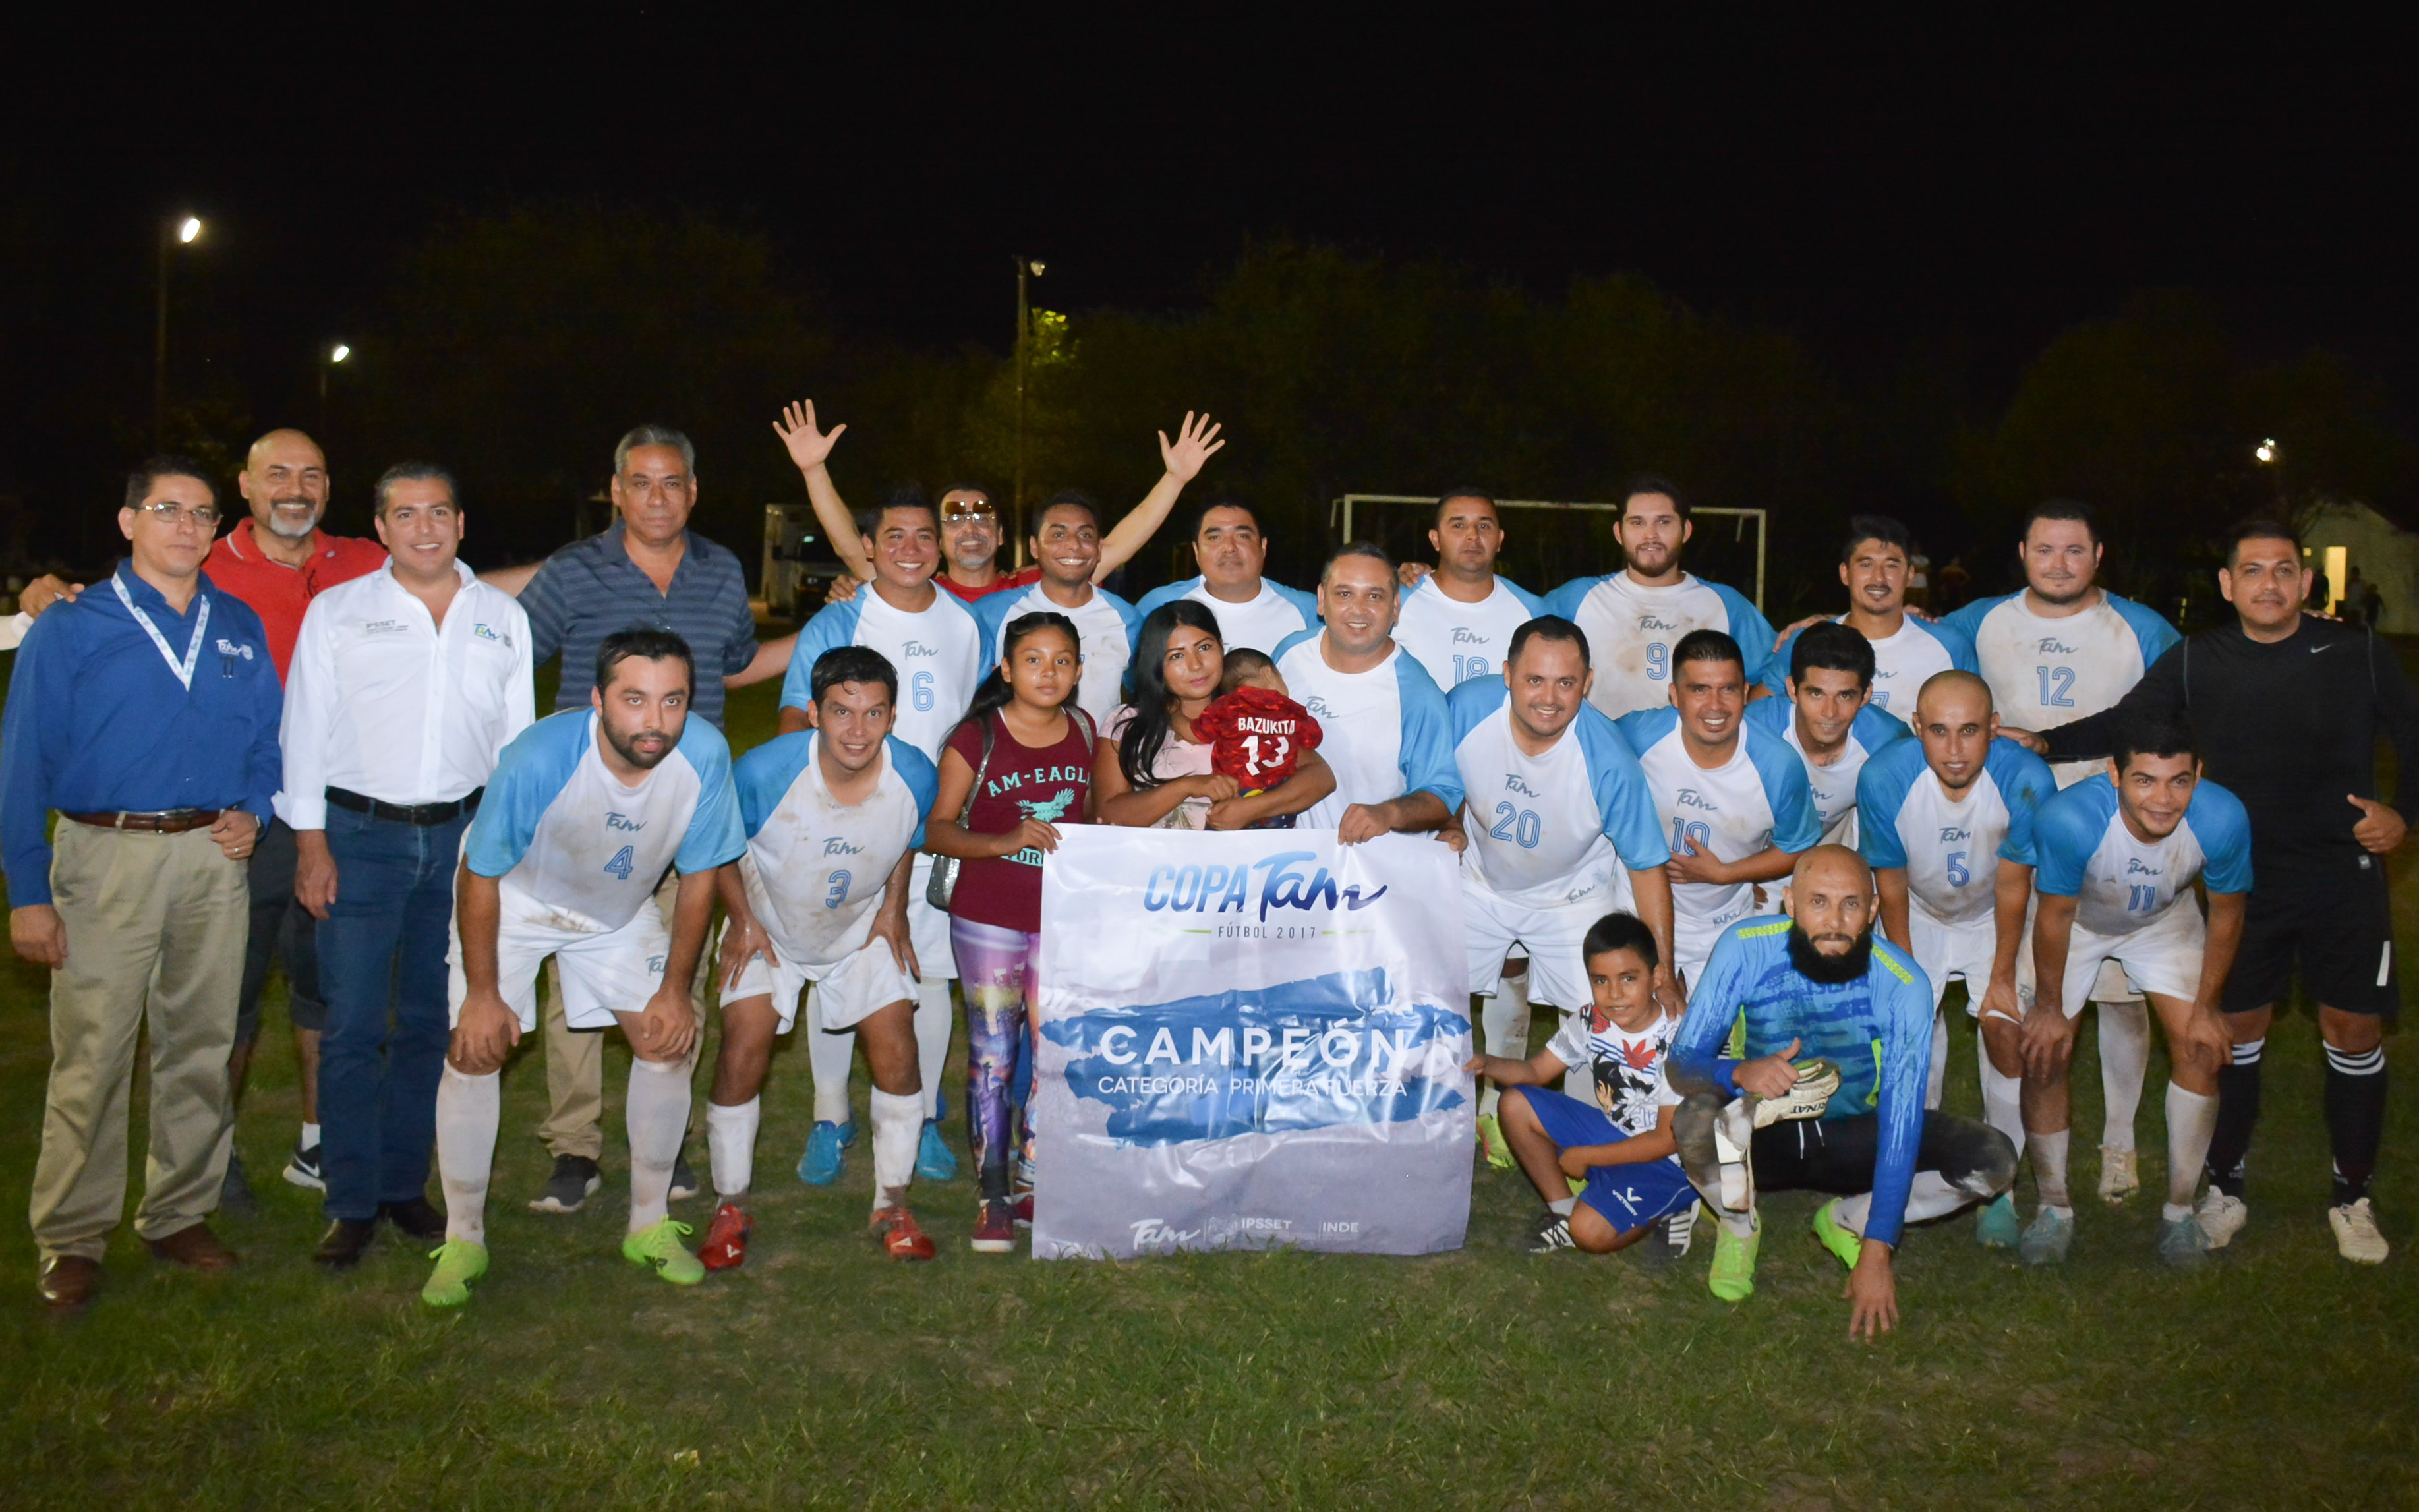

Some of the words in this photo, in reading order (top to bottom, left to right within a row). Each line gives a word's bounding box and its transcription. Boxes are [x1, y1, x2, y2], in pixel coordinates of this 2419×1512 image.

[1451, 627, 1490, 645] Tam
[1638, 615, 1677, 631] Tam
[902, 640, 939, 660] Tam
[2038, 637, 2078, 655] Tam
[1453, 654, 1489, 685] 18
[1647, 643, 1668, 680] 9
[912, 671, 935, 712] 6
[2037, 666, 2076, 707] 12
[1307, 696, 1340, 719] Tam
[1238, 717, 1295, 735] BAZUKITA
[1241, 735, 1289, 776] 13
[987, 765, 1090, 797] AM-EAGL
[1505, 774, 1541, 798] Tam
[1676, 788, 1718, 811] Tam
[605, 812, 648, 831] Tam
[1490, 801, 1541, 849] 20
[823, 837, 865, 858] Tam
[1672, 817, 1710, 856] 10
[1939, 827, 1971, 844] Tam
[604, 845, 633, 879] 4
[1948, 851, 1969, 888] 5
[826, 869, 852, 909] 3
[1144, 863, 1248, 913] COPA
[1253, 850, 1388, 923] Tam
[2128, 885, 2155, 911] 11
[1218, 922, 1268, 939] FÚTBOL
[1277, 927, 1316, 939] 2017
[645, 955, 668, 977] Ta
[1100, 1017, 1405, 1068] CAMPEÓN
[1098, 1074, 1219, 1095] CATEGORÍA
[1231, 1078, 1320, 1096] PRIMERA
[1326, 1079, 1408, 1097] FUERZA
[1130, 1219, 1201, 1250] Tam
[1242, 1217, 1293, 1230] IPSSET
[1323, 1221, 1360, 1233] INDE
